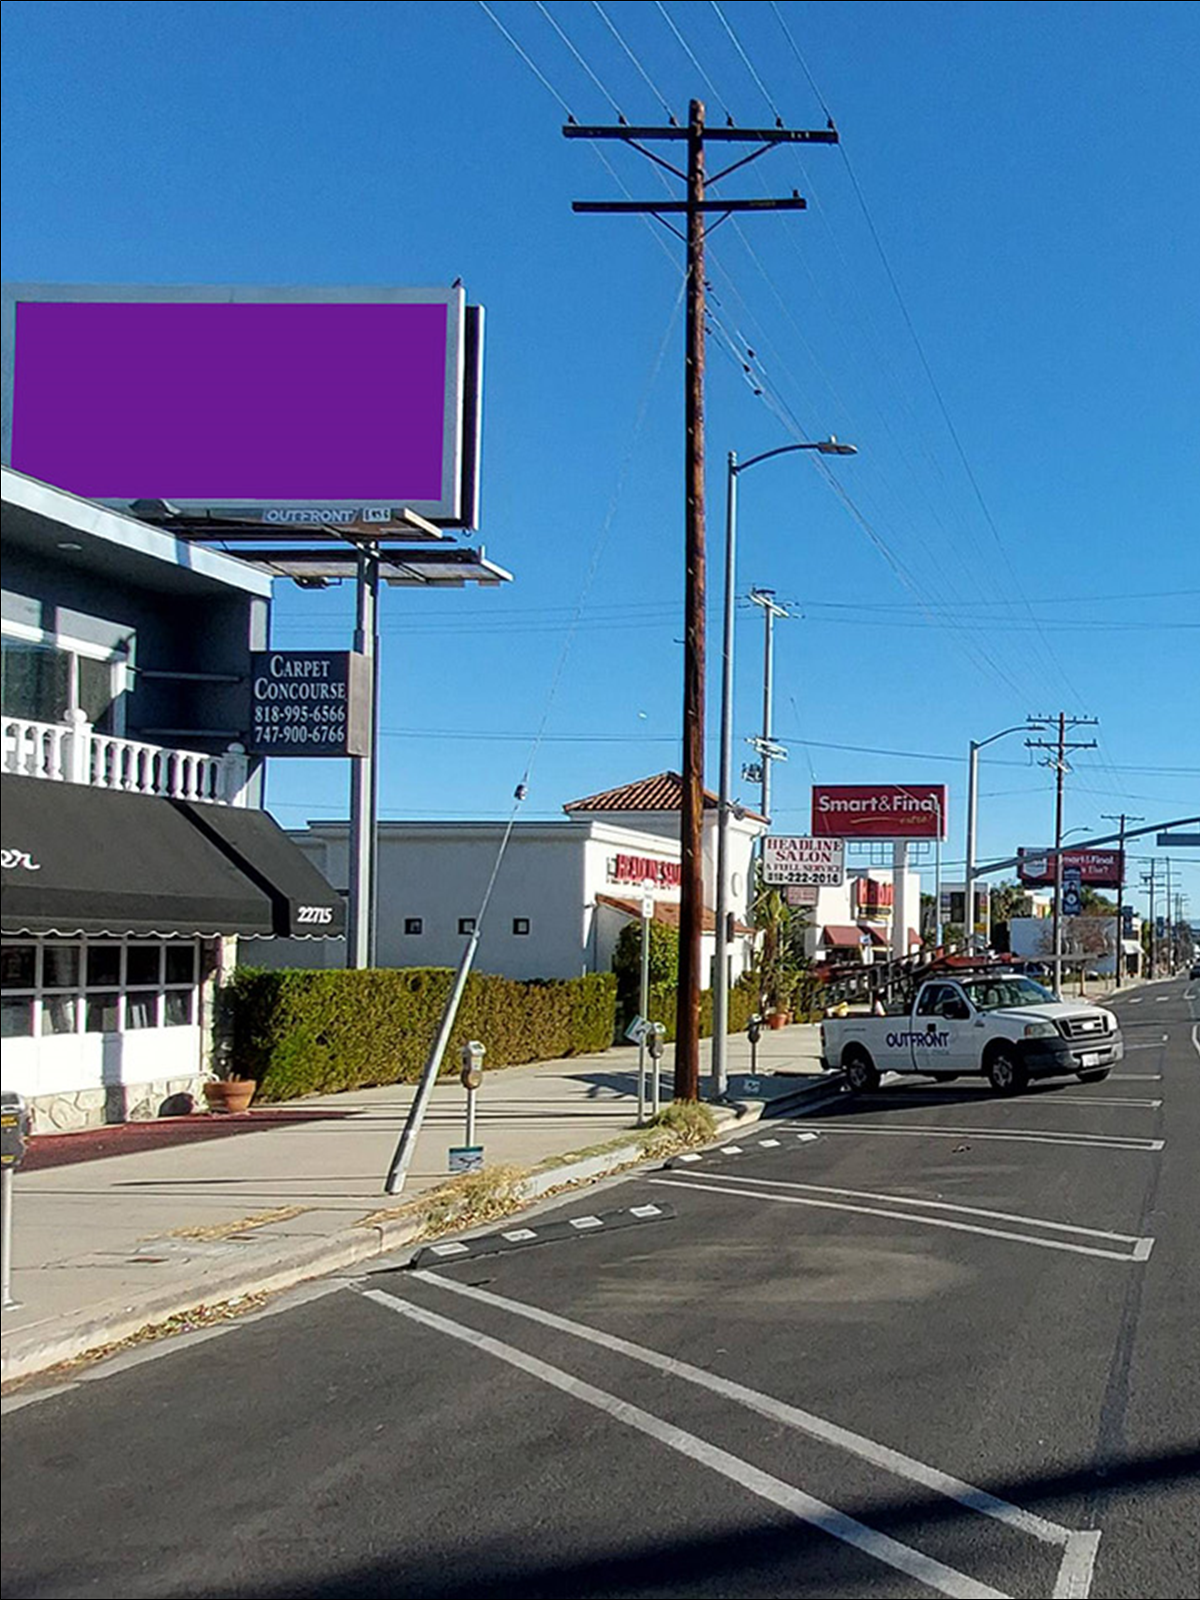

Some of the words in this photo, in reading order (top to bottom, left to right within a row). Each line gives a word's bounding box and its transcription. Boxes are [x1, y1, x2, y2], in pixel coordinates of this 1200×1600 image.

[266, 510, 353, 521] OUTFRONT
[270, 655, 330, 677] CARPET
[254, 677, 345, 700] CONCOURSE
[254, 705, 345, 722] 818-995-6566
[255, 725, 345, 743] 747-900-6766
[766, 839, 844, 851] HEADLINE
[775, 851, 832, 863] SALON
[297, 906, 333, 923] 22715
[886, 1032, 949, 1048] OUTFRONT
